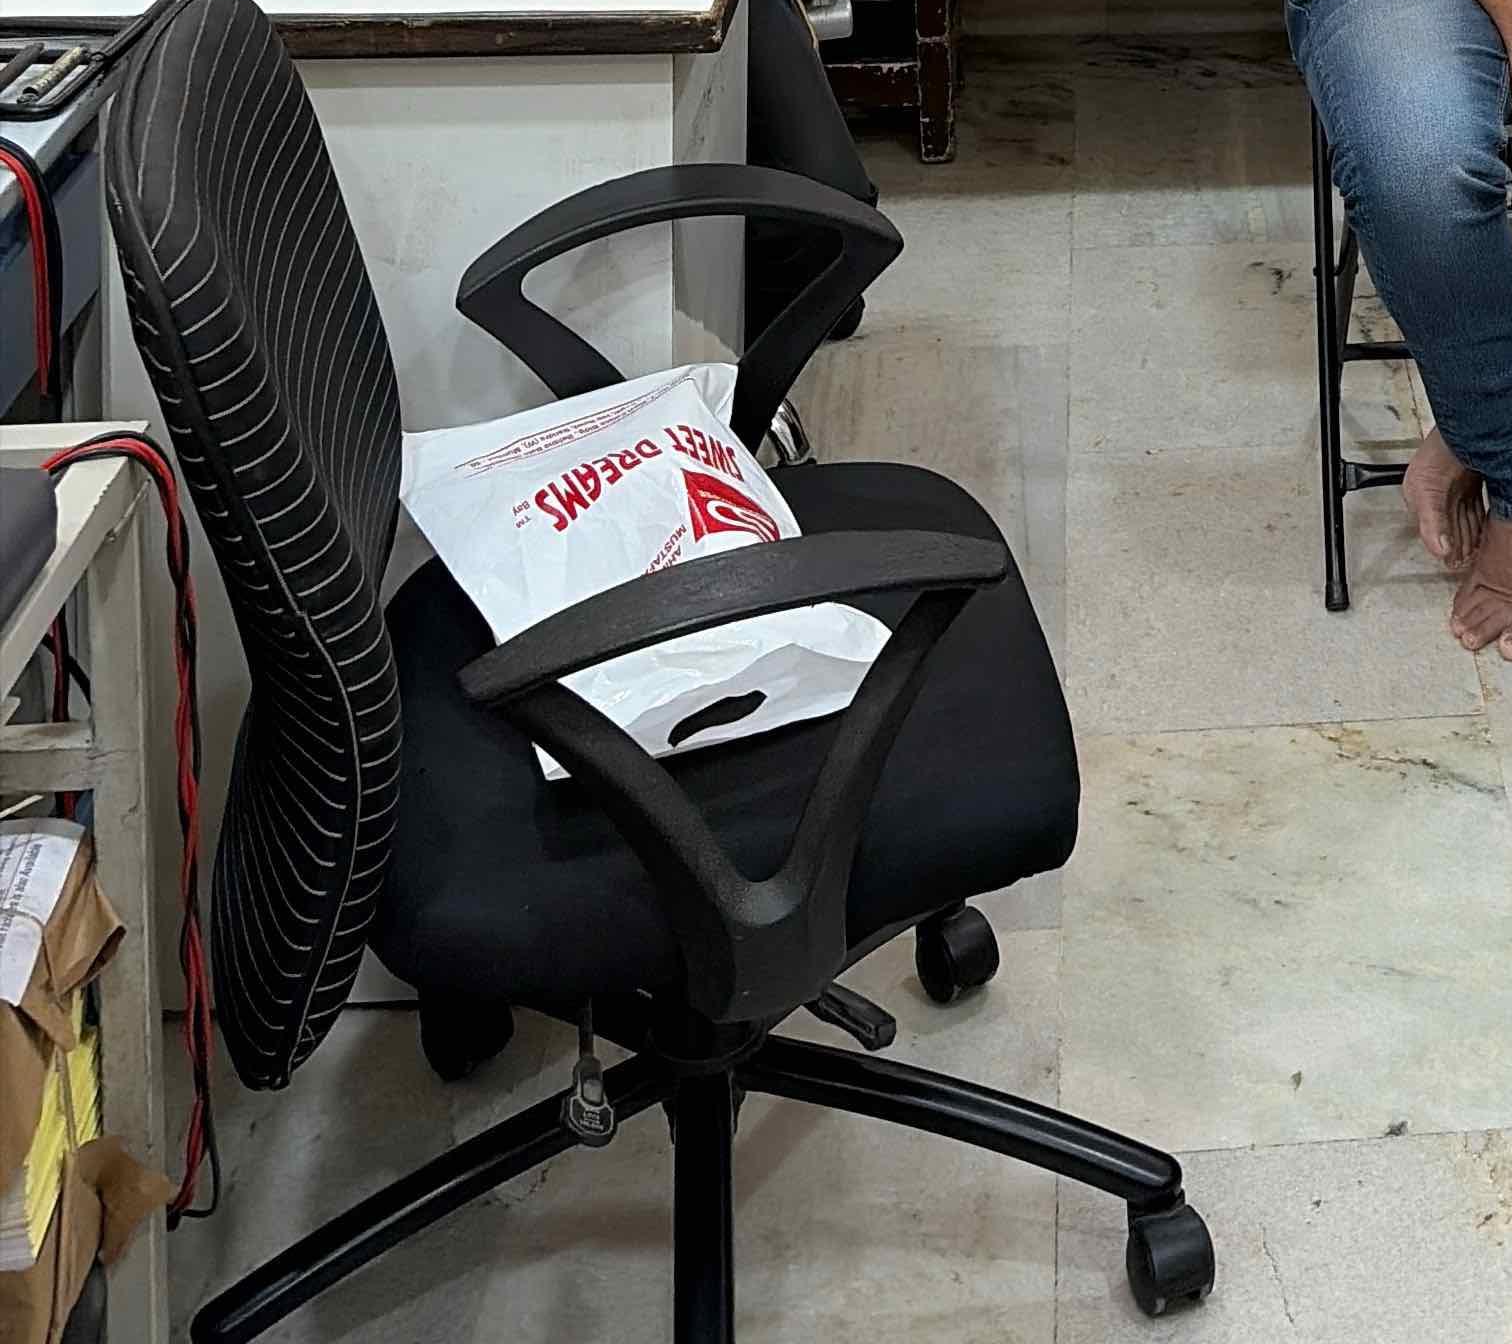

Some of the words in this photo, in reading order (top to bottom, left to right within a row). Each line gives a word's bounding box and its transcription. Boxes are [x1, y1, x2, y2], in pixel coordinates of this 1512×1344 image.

[663, 424, 745, 482] SWEET
[535, 438, 663, 532] DREAMS
[515, 515, 532, 529] TM
